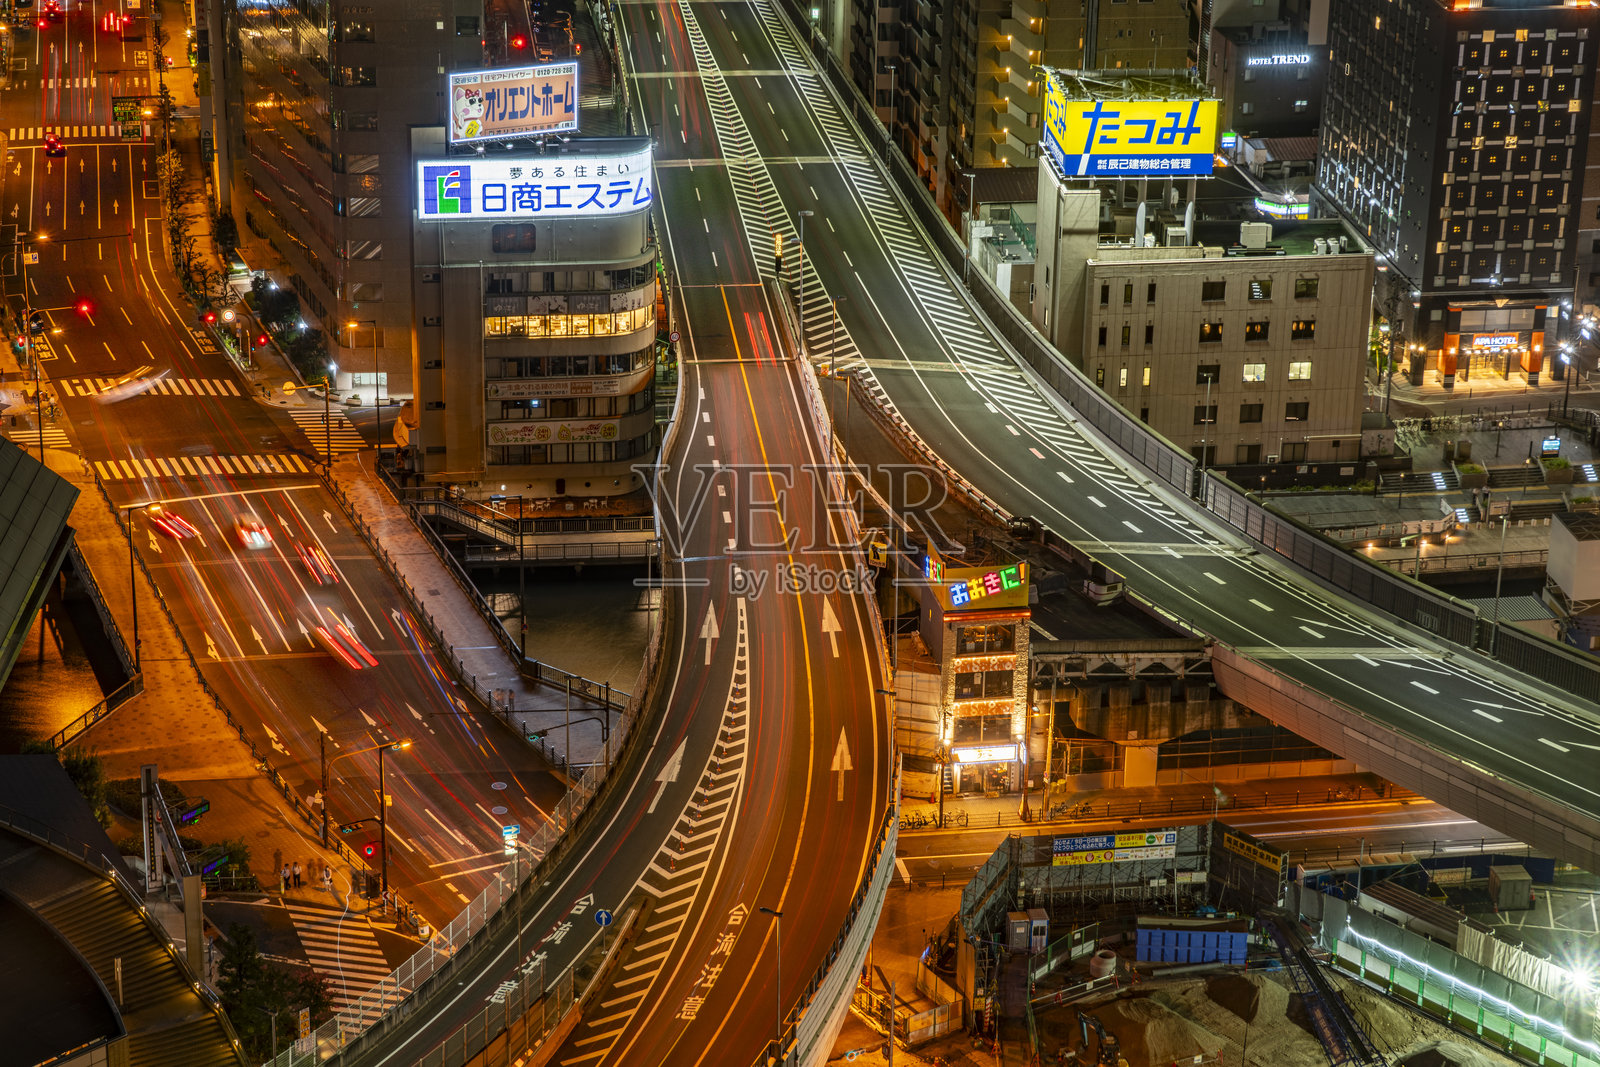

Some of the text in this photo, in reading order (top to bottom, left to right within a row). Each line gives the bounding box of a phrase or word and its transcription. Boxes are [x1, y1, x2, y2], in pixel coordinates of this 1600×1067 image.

[1248, 54, 1310, 66] HOTEL TREND
[485, 81, 575, 122] オリエントホーム
[1082, 101, 1201, 154] たつみ
[509, 164, 630, 180] 夢ある住まい
[482, 177, 653, 212] 日商エステム
[1491, 336, 1517, 344] HOTEL
[950, 562, 1026, 606] おおきに!
[675, 902, 749, 1020] 合流注意
